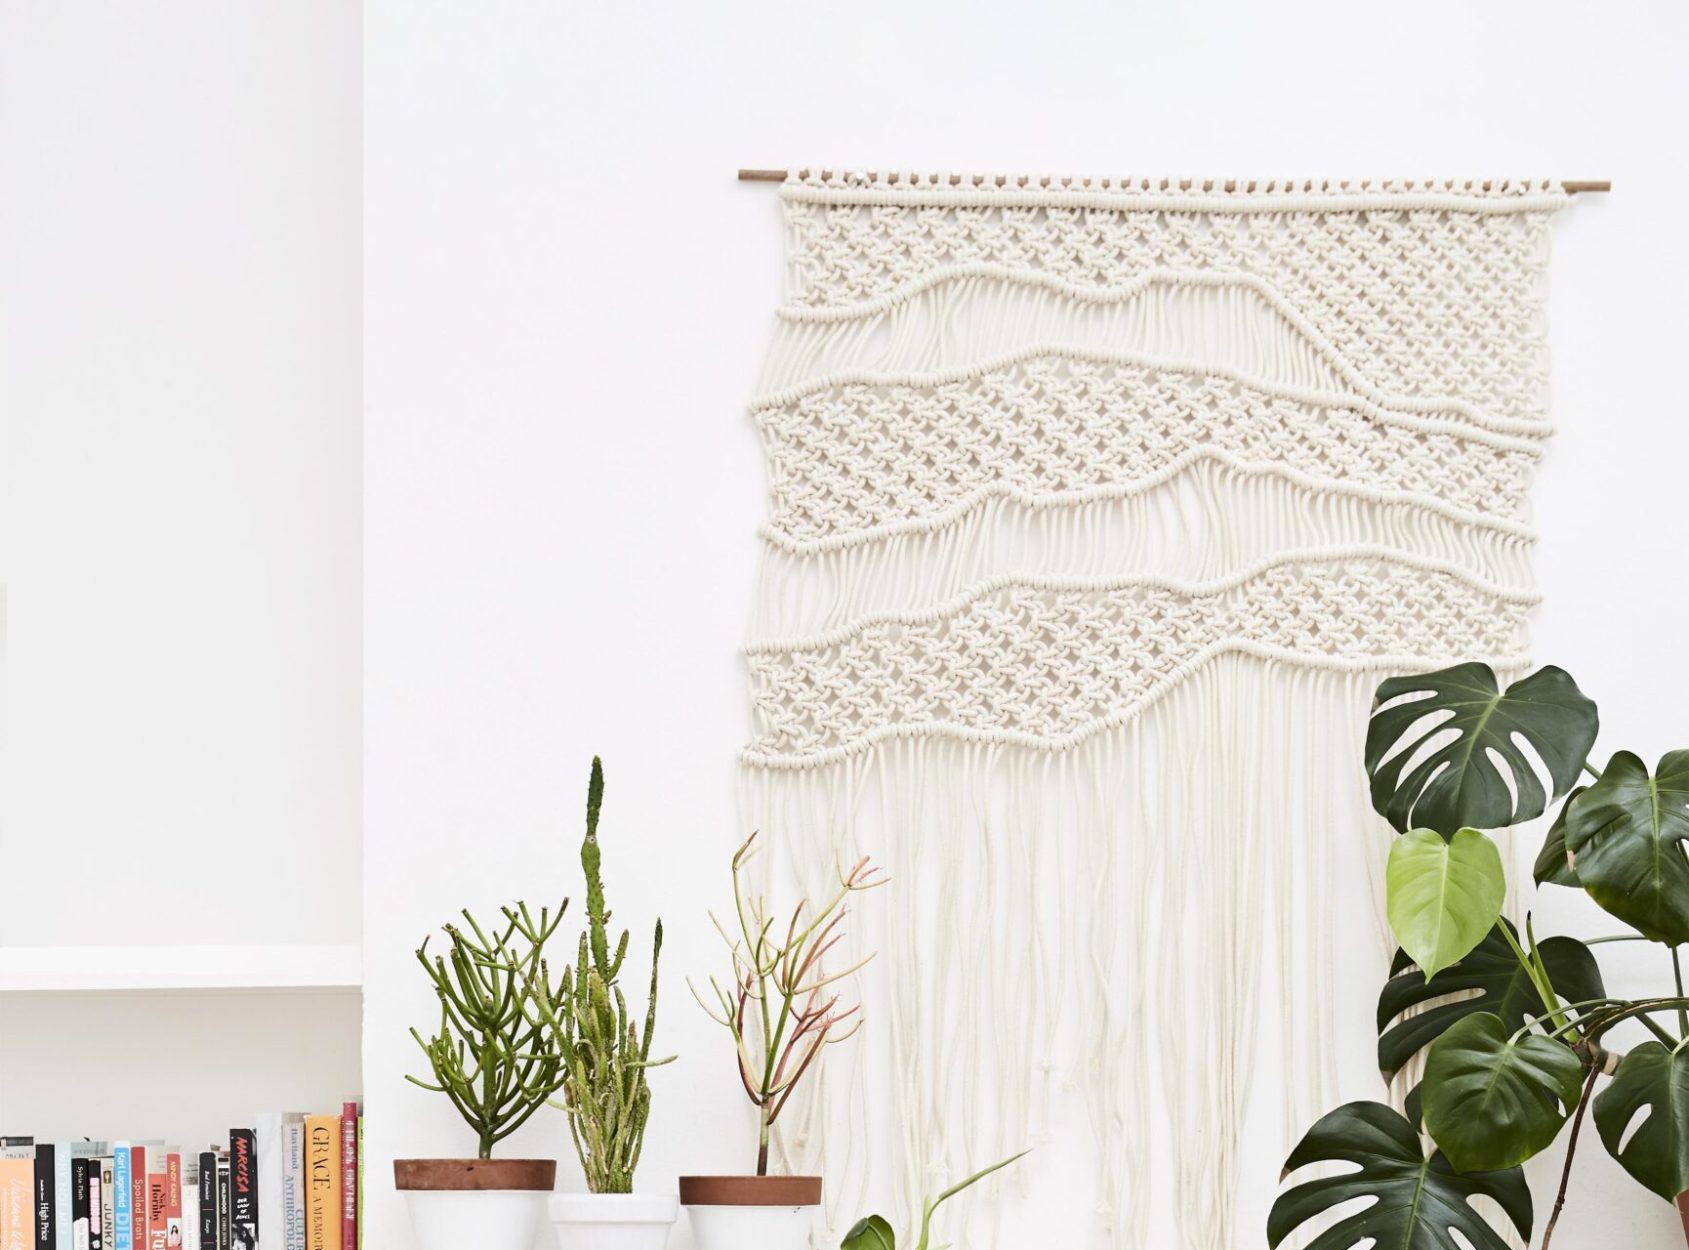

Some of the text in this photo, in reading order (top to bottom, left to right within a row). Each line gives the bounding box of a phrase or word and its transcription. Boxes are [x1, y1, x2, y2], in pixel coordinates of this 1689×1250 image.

[236, 1136, 249, 1193] NARCISA
[289, 1128, 299, 1169] Haviland
[311, 1126, 331, 1190] GRACE
[76, 1166, 86, 1200] Sylvia Plath
[116, 1152, 127, 1208] Karl Lagerfeld
[159, 1193, 167, 1209] Nick
[170, 1161, 178, 1207] MINDY KALING
[38, 1202, 49, 1240] High Price
[104, 1203, 113, 1248] JUNKY
[133, 1179, 144, 1240] Spoiled Brats
[149, 1184, 162, 1222] Hornby
